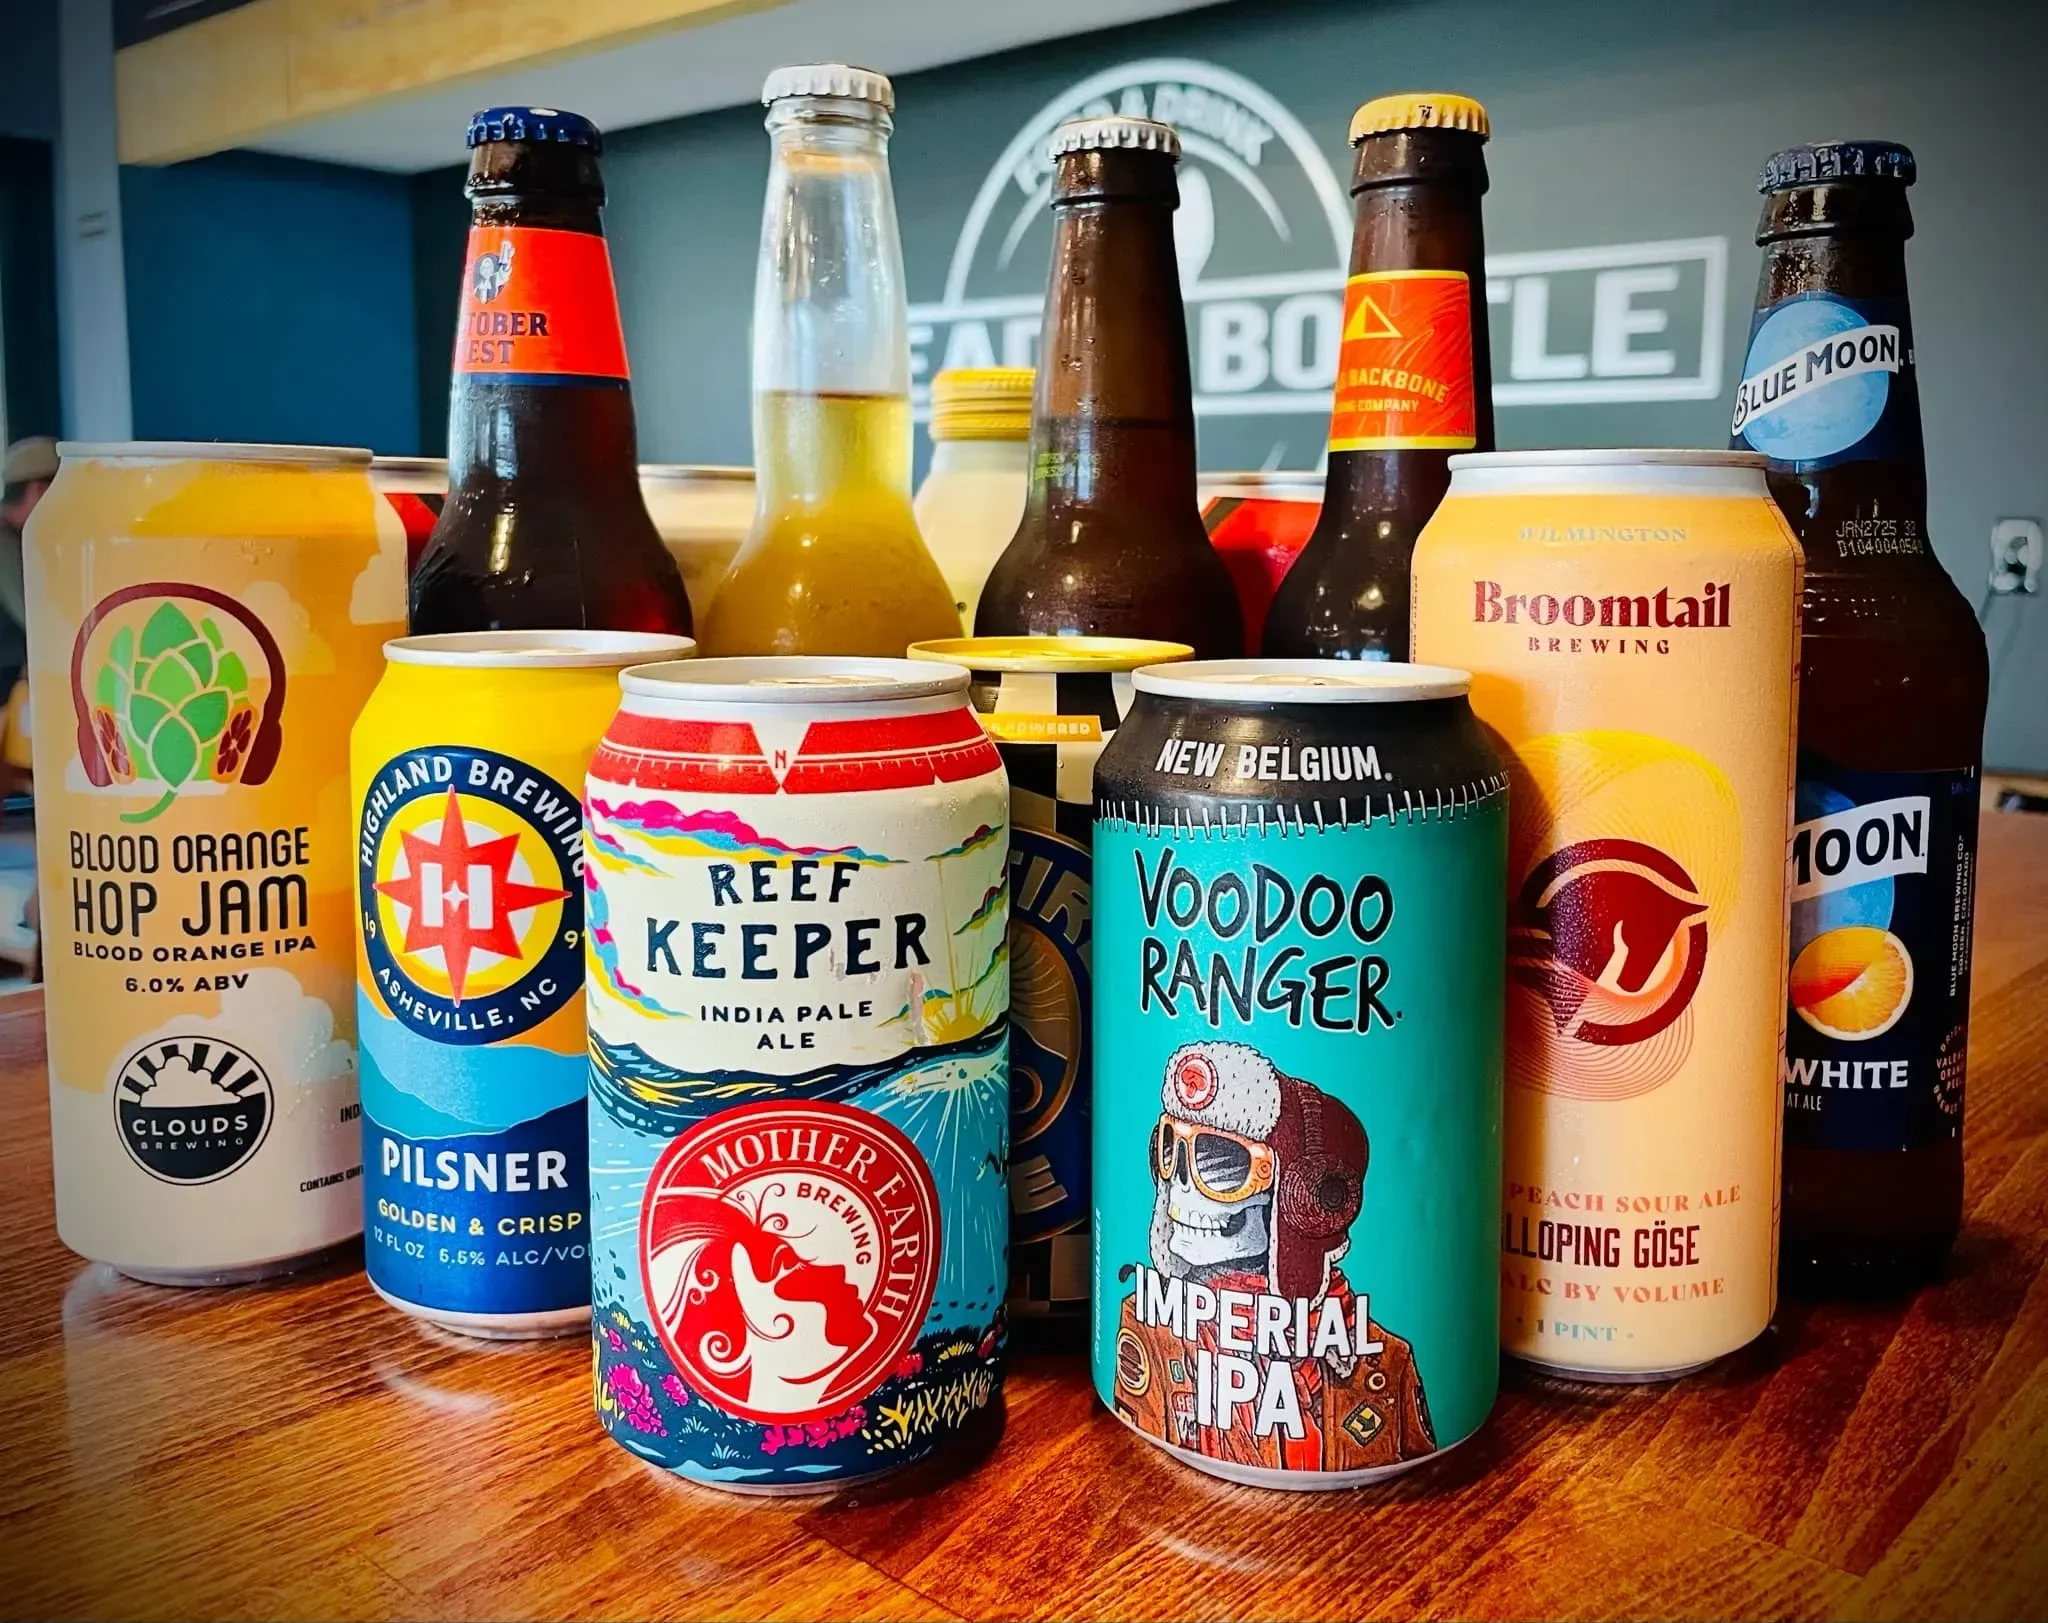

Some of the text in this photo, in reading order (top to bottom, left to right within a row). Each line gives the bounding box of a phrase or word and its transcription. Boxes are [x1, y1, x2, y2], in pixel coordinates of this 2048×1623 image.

[465, 311, 550, 336] TOBER
[466, 340, 515, 364] EST
[1349, 367, 1450, 404] BACKBONE
[1733, 333, 1896, 430] BLUE MOON
[1358, 398, 1420, 412] COMPANY
[1518, 527, 1688, 543] WILMINGTON
[1471, 580, 1731, 629] Broomtail
[1528, 636, 1671, 655] BREWING
[1155, 738, 1226, 777] NEW
[360, 756, 452, 867] HIGHLAND
[70, 827, 310, 874] BLOOD ORANGE
[707, 859, 861, 907] REEF
[1134, 847, 1395, 944] VOODOO
[73, 874, 308, 937] HOP JAM
[74, 936, 317, 962] BLOOD ORANGE IPA
[645, 912, 932, 981] KEEPER
[126, 973, 250, 993] 6.0% ABV
[378, 967, 557, 1031] ASHEVILLE, NC
[700, 1001, 874, 1024] INDIA PALE
[756, 1032, 815, 1050] ALE
[1785, 1059, 1909, 1089] WHITE
[340, 1103, 361, 1123] IND
[1803, 1094, 1822, 1111] ALE
[132, 1114, 249, 1136] CLOUDS
[140, 1137, 244, 1150] BREWING
[382, 1137, 569, 1193] PILSNER
[1510, 1182, 1742, 1214] PEACH SOUR ALE
[378, 1198, 583, 1236] GOLDEN & CRISP
[700, 1128, 921, 1321] MOTHER EARTH
[796, 1182, 872, 1266] BREWING
[374, 1226, 384, 1244] 12
[386, 1236, 401, 1252] FL
[404, 1241, 425, 1259] OZ
[1503, 1212, 1700, 1269] LLOPING GÖSE
[1564, 1281, 1601, 1302] BY
[1613, 1277, 1725, 1304] VOLUME
[1134, 1262, 1384, 1358] IMPERIAL
[1554, 1320, 1618, 1342] PINT
[1195, 1348, 1306, 1440] IPA
